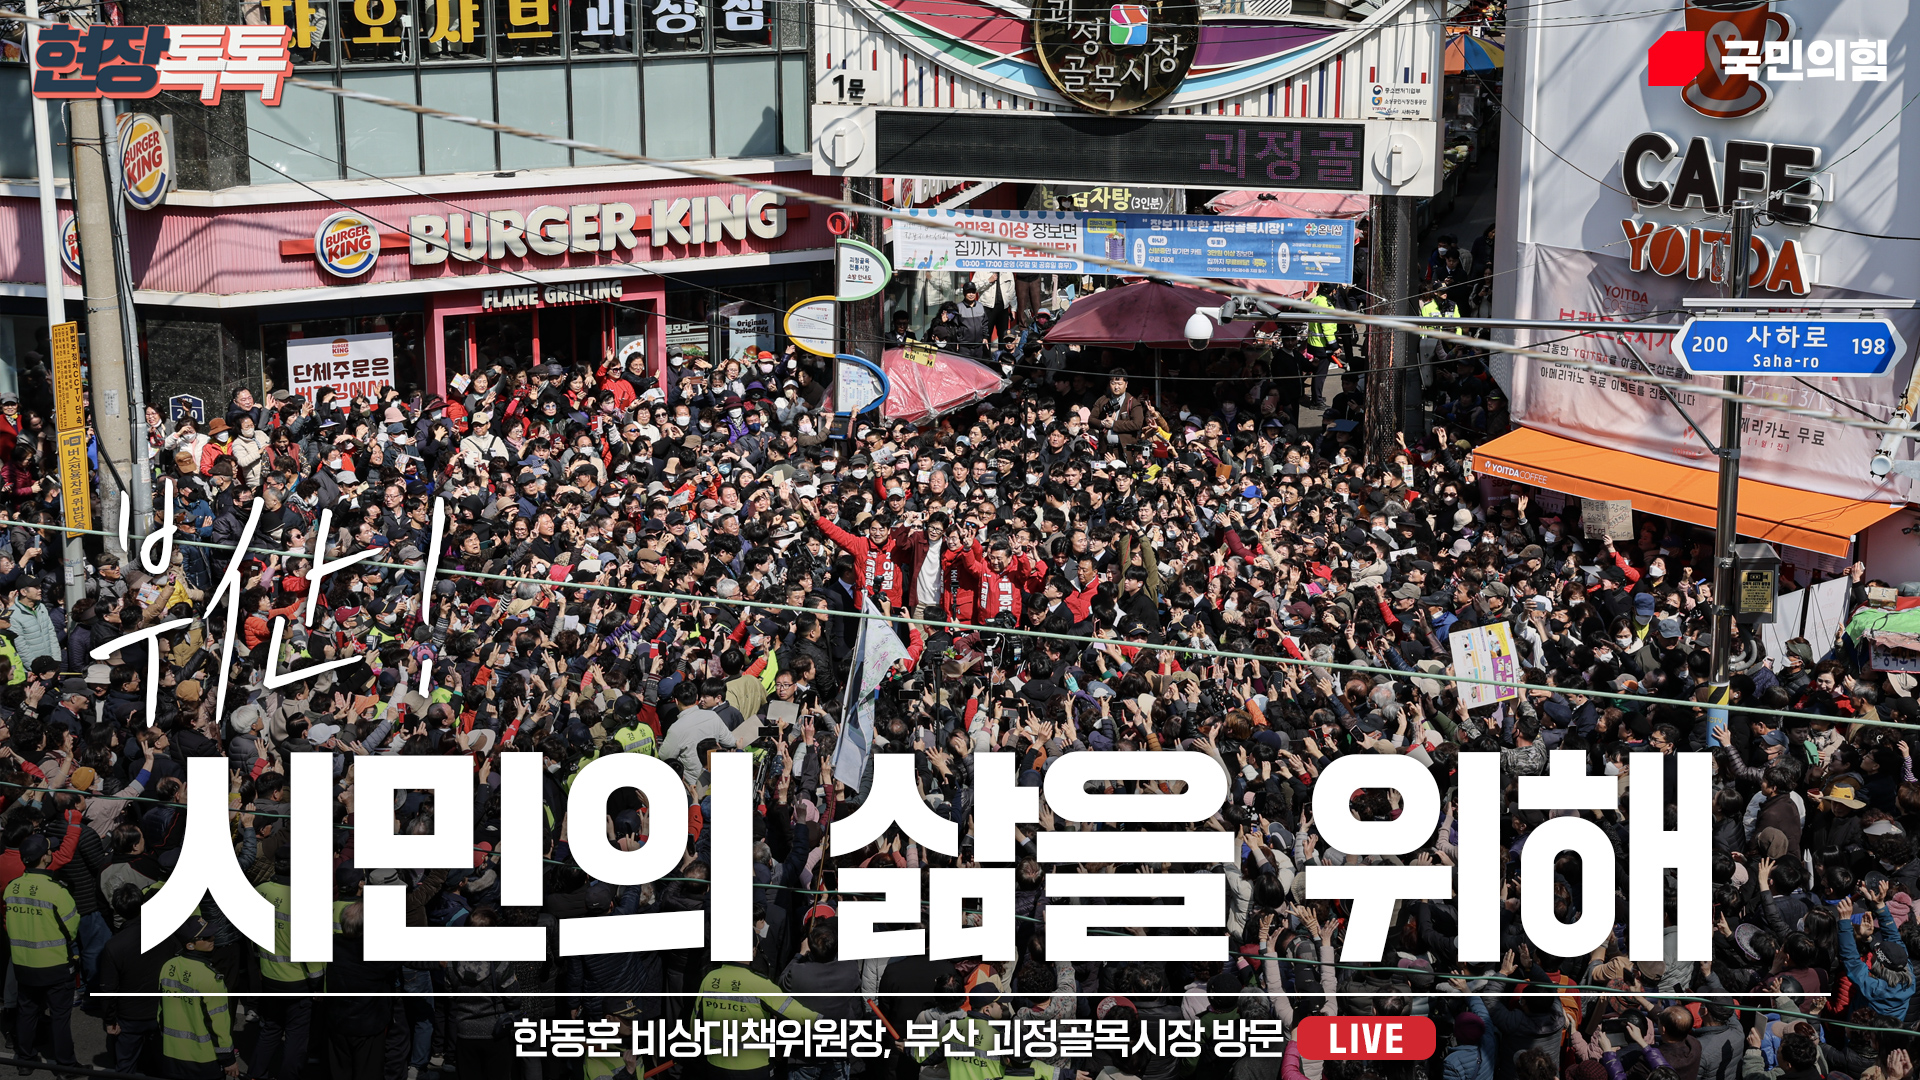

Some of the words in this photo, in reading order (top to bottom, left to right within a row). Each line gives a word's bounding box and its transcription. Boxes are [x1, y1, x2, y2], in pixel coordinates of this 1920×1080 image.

[832, 75, 866, 101] 1문
[124, 131, 161, 168] BURGER
[1199, 129, 1361, 182] 괴정골
[126, 145, 163, 191] KING
[1622, 131, 1821, 225] CAFE
[1131, 196, 1163, 211] (3인분)
[325, 224, 370, 249] BURGER
[409, 203, 639, 265] BURGER
[651, 190, 788, 248] KING
[998, 222, 1029, 239] 이상
[1032, 222, 1078, 239] 장보면
[1150, 219, 1184, 232] 장보기
[1187, 220, 1210, 233] 편한
[1212, 220, 1285, 235] 괴정골목시장!
[328, 235, 372, 264] KING
[954, 240, 1002, 257] 집까지
[1620, 218, 1812, 296] YOITDA
[962, 260, 981, 268] 10:00
[985, 260, 1003, 268] 17:00
[482, 287, 539, 309] FLAME
[544, 280, 623, 304] GRILLING
[1603, 284, 1649, 304] YOITDA
[736, 319, 768, 328] Originals
[1543, 343, 1568, 357] 그동안
[1692, 336, 1728, 353] 200
[1746, 326, 1828, 349] 사하로
[1852, 338, 1886, 355] 198
[292, 357, 390, 384] 단체주문은
[1753, 354, 1820, 368] Saha-ro
[1540, 366, 1585, 385] 아메리카노
[1590, 375, 1607, 389] 무료
[1611, 379, 1645, 397] 이벤트를
[176, 408, 198, 420] 20
[1741, 417, 1791, 441] 메리카노
[1797, 427, 1826, 447] 무료
[67, 447, 83, 497] 버스전용차로
[627, 728, 646, 742] 경찰
[12, 883, 38, 897] 경찰
[6, 905, 43, 916] POLICE
[168, 964, 192, 983] 경찰
[711, 978, 741, 992] 경찰
[705, 1001, 747, 1012] POLICE
